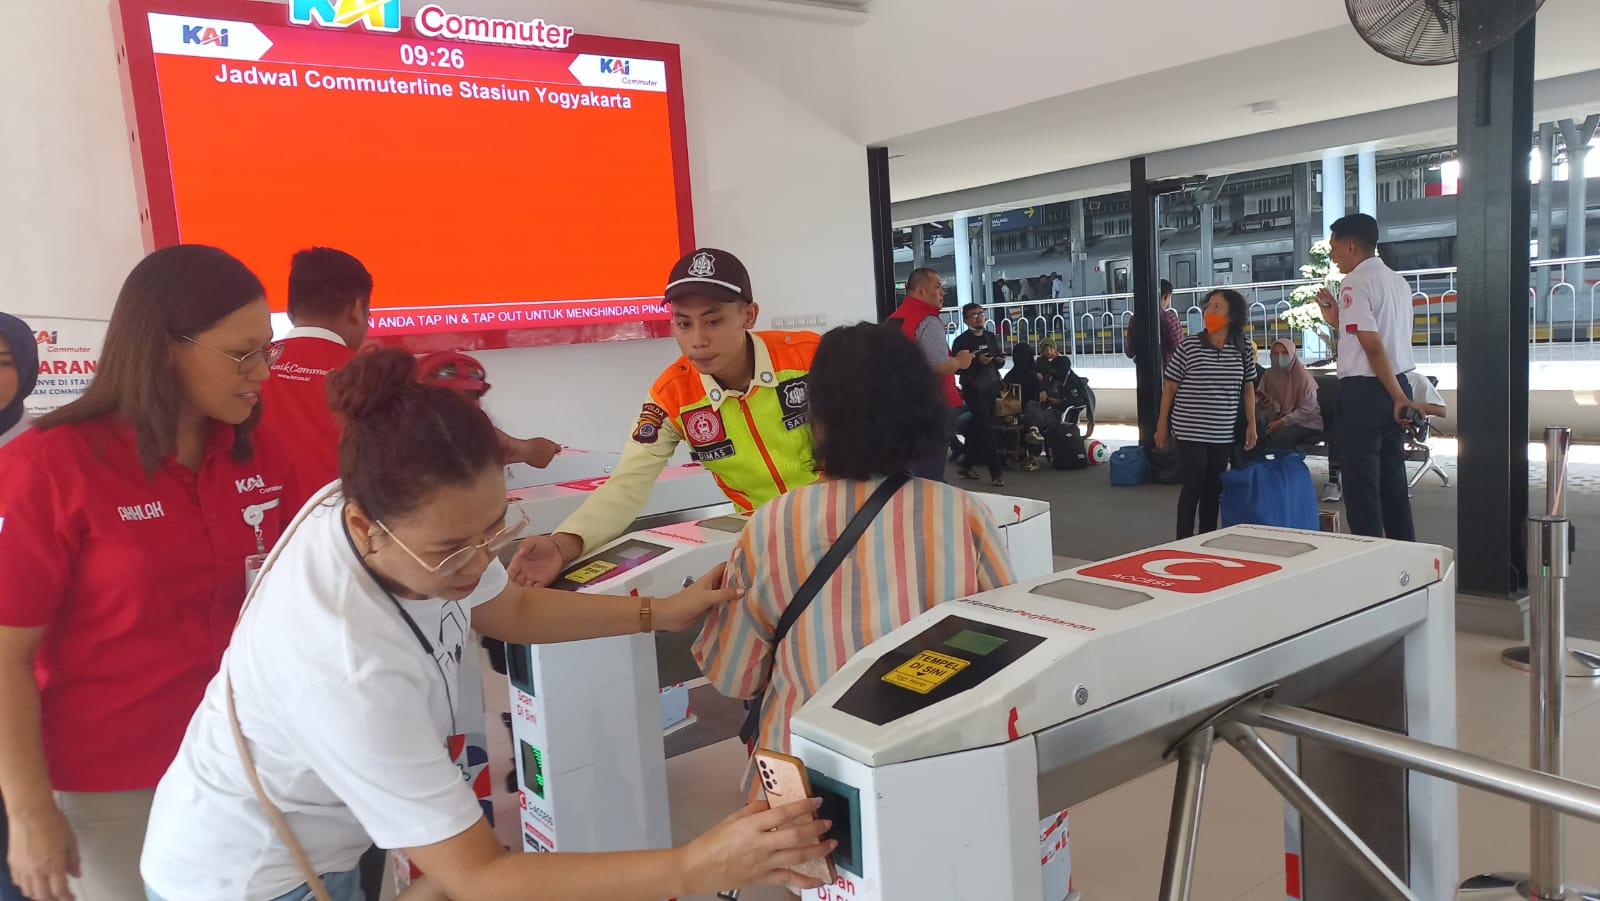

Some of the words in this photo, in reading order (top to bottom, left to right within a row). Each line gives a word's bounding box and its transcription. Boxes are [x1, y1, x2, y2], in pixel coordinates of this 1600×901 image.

[418, 5, 574, 46] Commuter
[400, 44, 465, 69] 09:26
[215, 64, 298, 87] Jadwal
[304, 70, 453, 98] Commuterline
[459, 81, 530, 103] Stasiun
[535, 86, 632, 110] Yogyakarta
[621, 77, 659, 88] Commuter
[378, 315, 415, 328] ANDA
[417, 314, 443, 327] TAP
[445, 313, 458, 325] IN
[460, 313, 469, 324] &
[471, 311, 495, 324] TAP
[498, 310, 522, 322] OUT
[525, 308, 564, 321] UNTUK
[566, 305, 640, 318] MENGHINDARI
[32, 330, 58, 345] AI
[47, 345, 92, 353] Commuter
[1110, 573, 1176, 587] ACCESS
[909, 661, 923, 670] DI
[922, 665, 947, 677] SINI
[918, 653, 960, 671] TEMPEL
[836, 875, 855, 896] an
